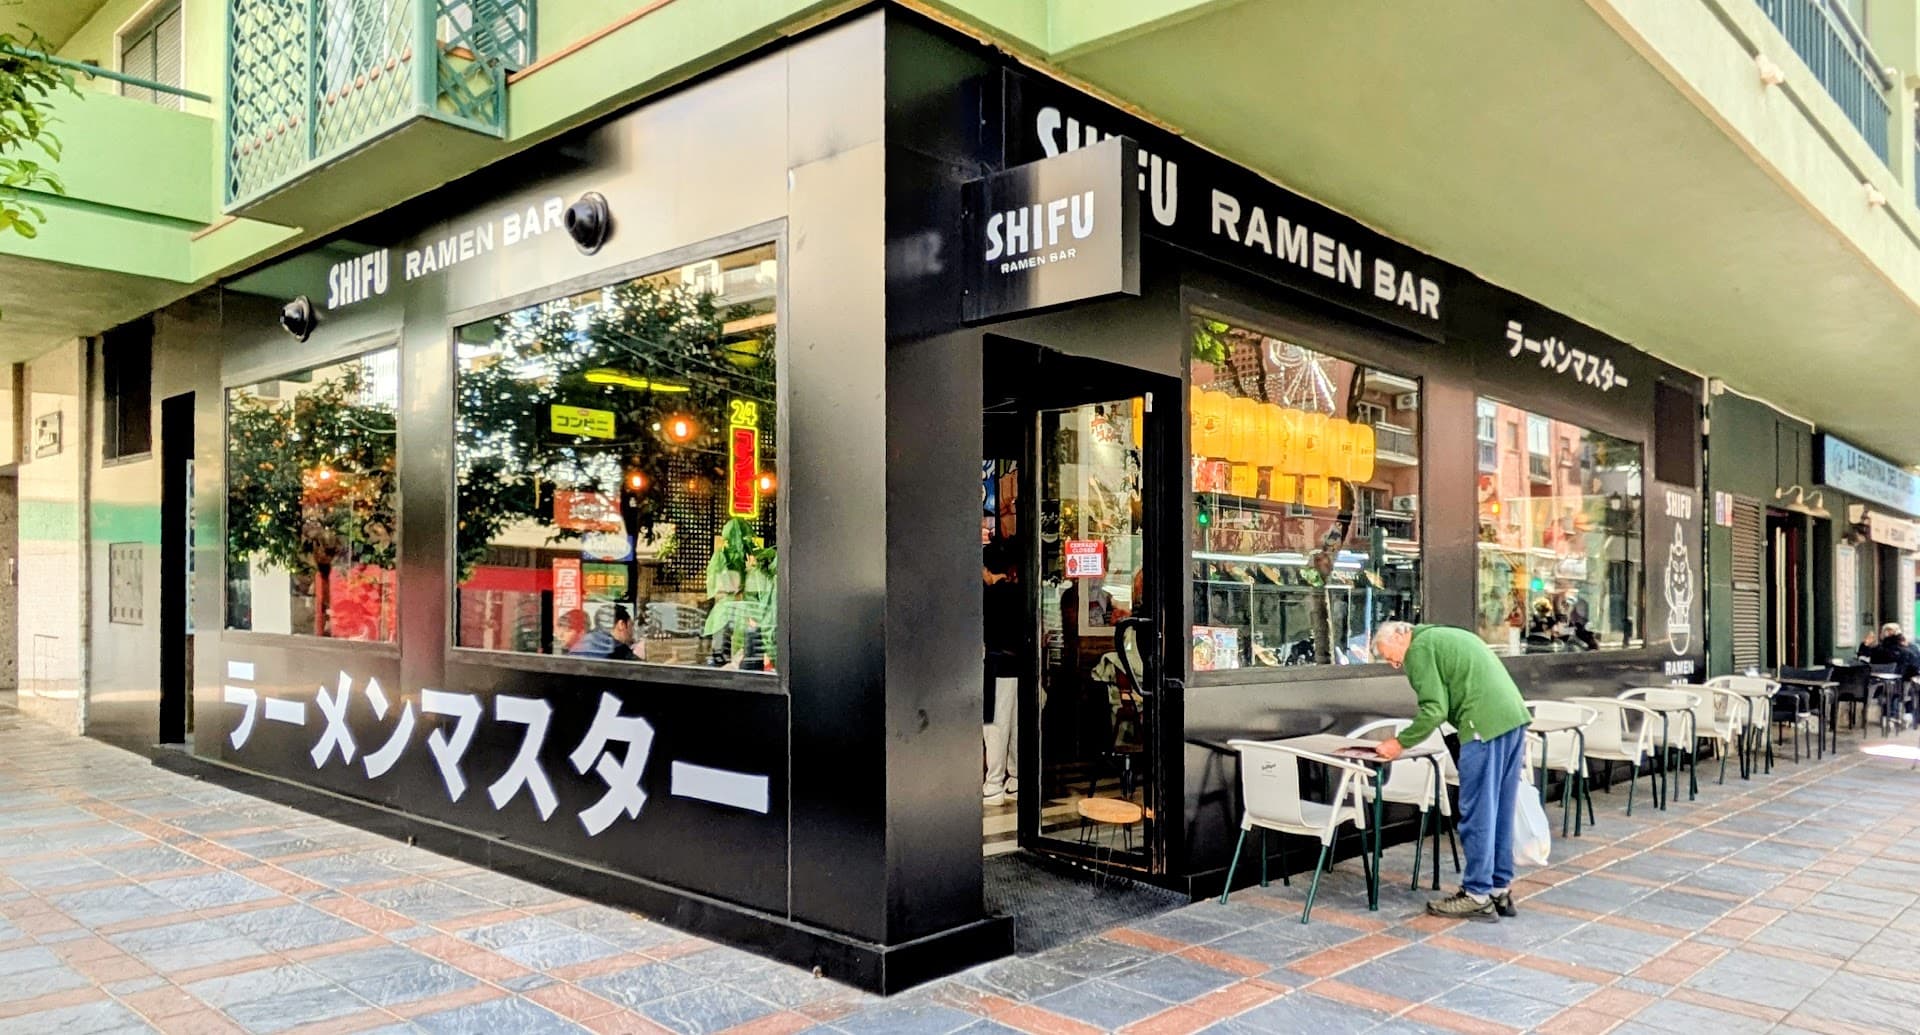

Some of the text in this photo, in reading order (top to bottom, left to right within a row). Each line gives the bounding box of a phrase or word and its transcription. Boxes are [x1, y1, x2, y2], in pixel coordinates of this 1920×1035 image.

[328, 196, 564, 310] SHIFU RAMEN BAR
[985, 191, 1095, 262] SHIFU
[1001, 248, 1077, 274] RAMEN BAR
[1211, 188, 1440, 320] RAMEN BAR
[1506, 320, 1629, 392] ラーメンマスター
[731, 399, 758, 426] 24
[1665, 490, 1692, 520] SHIFU
[1664, 659, 1695, 676] RAMEN
[224, 660, 770, 837] ラーメンマスター
